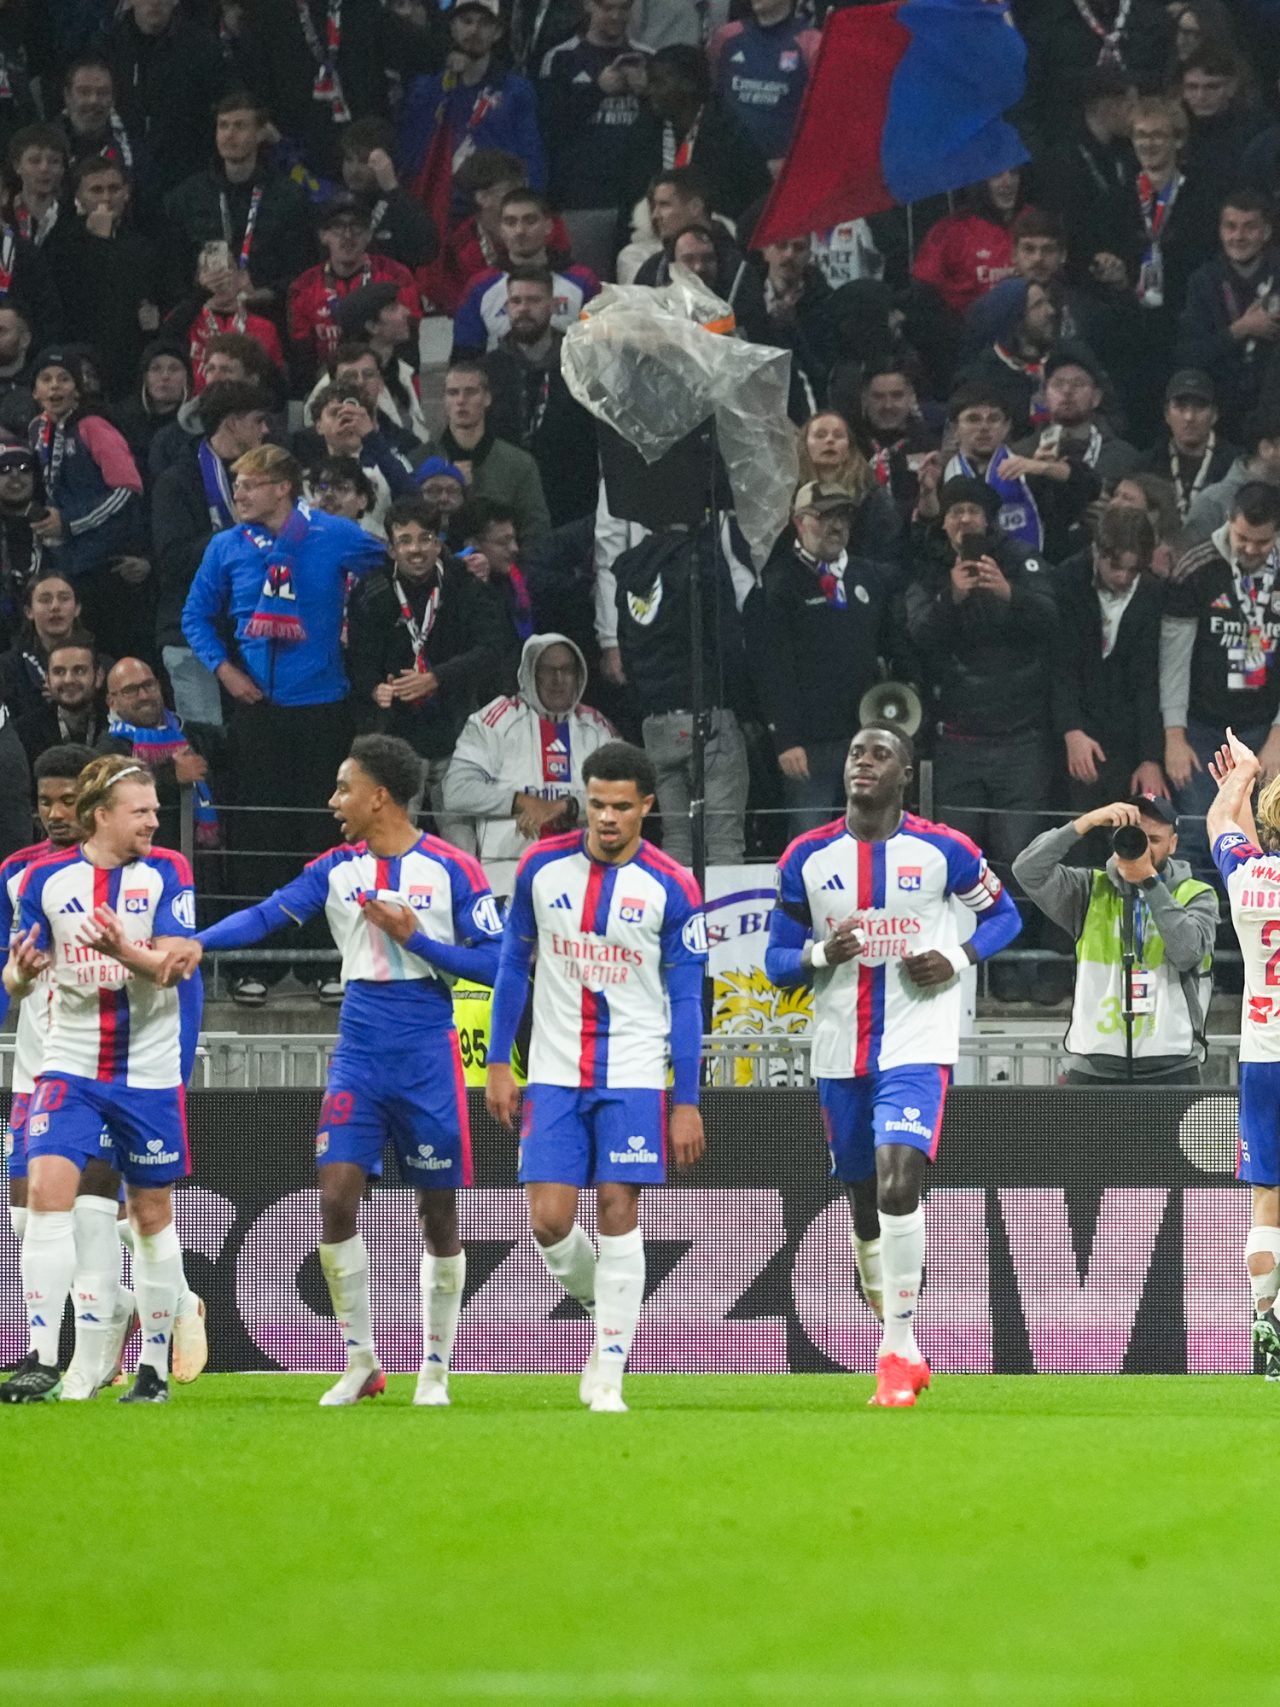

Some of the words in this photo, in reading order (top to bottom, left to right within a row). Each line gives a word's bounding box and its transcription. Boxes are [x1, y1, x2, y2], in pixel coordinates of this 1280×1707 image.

[900, 877, 920, 889] OL
[126, 900, 148, 911] OL
[410, 895, 431, 908] OL
[622, 907, 643, 920] OL
[552, 932, 644, 966] Emirates
[582, 964, 629, 984] BETTER
[459, 1028, 488, 1069] 95
[885, 1119, 933, 1140] trainline
[129, 1151, 180, 1165] trainline
[406, 1154, 452, 1170] trainline
[609, 1148, 658, 1163] trainline
